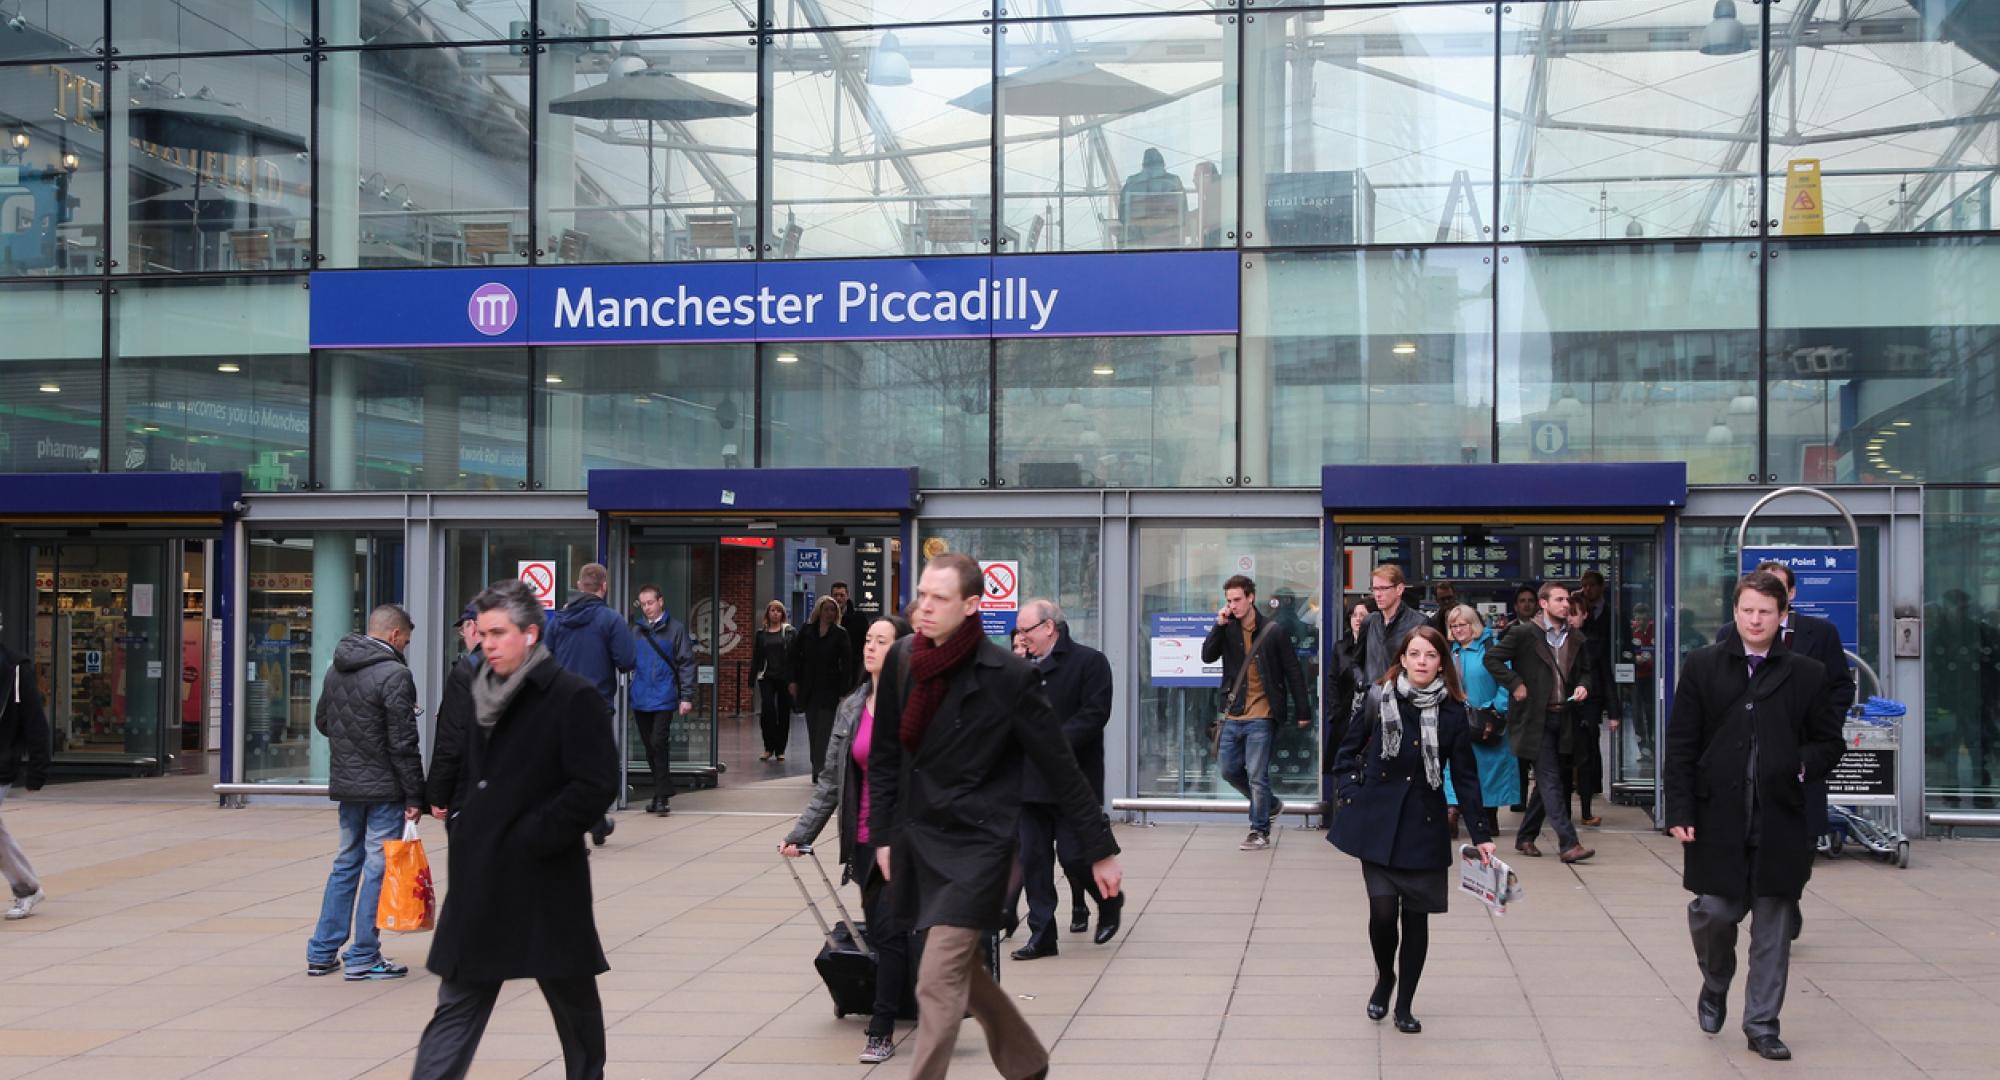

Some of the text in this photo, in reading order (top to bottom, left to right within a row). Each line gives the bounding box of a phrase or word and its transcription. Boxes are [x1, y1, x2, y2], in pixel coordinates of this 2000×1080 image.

[50, 65, 104, 133] TH
[1301, 195, 1336, 209] Lager
[554, 277, 1059, 330] Manchester Piccadilly
[170, 454, 207, 473] beuty
[800, 551, 818, 560] LIFT
[1791, 557, 1817, 567] Point
[798, 561, 821, 569] ONLY
